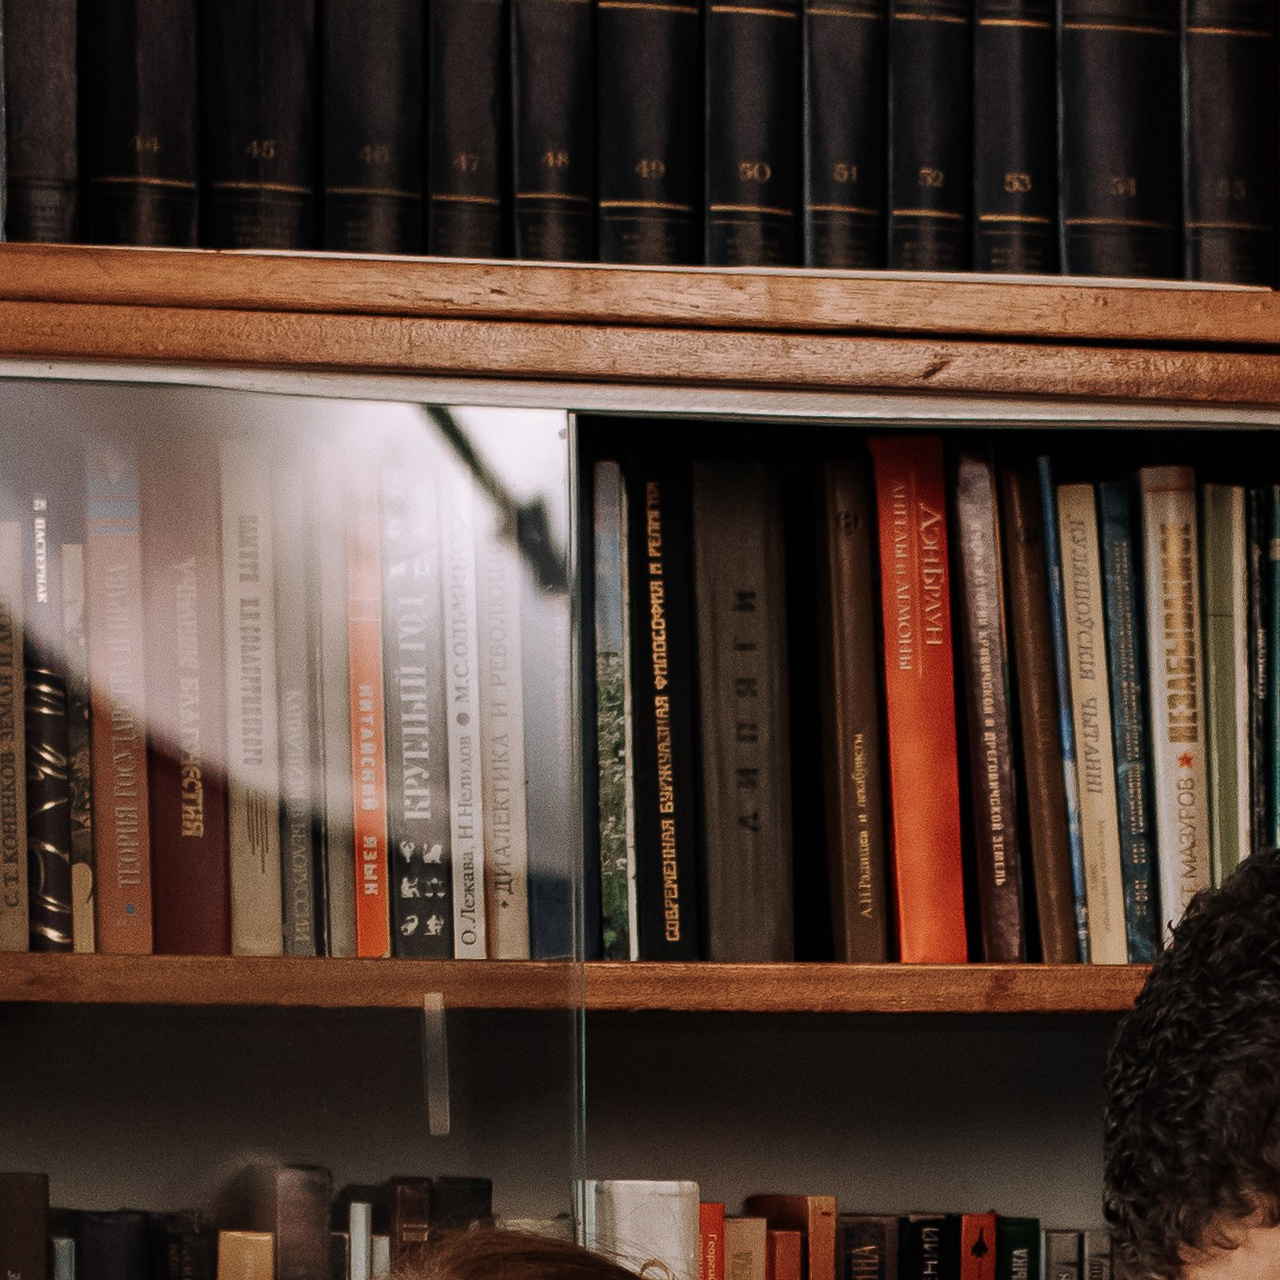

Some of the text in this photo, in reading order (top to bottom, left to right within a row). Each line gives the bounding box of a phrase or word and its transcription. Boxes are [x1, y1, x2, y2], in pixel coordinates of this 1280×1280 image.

[246, 139, 275, 159] 45
[452, 153, 480, 172] 47
[545, 151, 570, 169] 48
[634, 160, 667, 179] 49
[738, 161, 772, 184] 50
[833, 164, 858, 183] 51
[918, 168, 946, 188] 52
[1003, 173, 1033, 193] 53
[34, 517, 48, 604] ПАСТЕРНАК
[649, 562, 663, 576] И
[1066, 515, 1096, 680] КУЛЯШОЎСКІЯ
[396, 593, 430, 652] ГОД
[648, 580, 669, 691] ФИЛОСОФИЯ
[0, 674, 16, 742] ЗЕМЛЯ
[979, 630, 996, 716] КРИВИЧСКОЙ
[179, 677, 205, 838] БЛАГОЧЕСТИЯ
[359, 683, 378, 811] КИТАЙСКИЙ
[395, 664, 433, 821] КРУГЛЫЙ
[453, 734, 474, 817] Нелидов
[653, 695, 677, 814] БУРЖУАЗНАЯ
[850, 733, 867, 808] декабристы
[984, 730, 1004, 831] ДРЕГОВИЧСКОЙ
[1079, 697, 1104, 795] ЧЫТАННІ
[490, 700, 518, 893] ДИАЛЕКТИКА И
[1177, 777, 1198, 879] МАЗУРОВ
[114, 805, 142, 889] ТЕОРИЯ
[290, 822, 312, 941] БЕЛОРУССИИ
[659, 818, 681, 942] СОВРЕМЕННАЯ
[991, 835, 1007, 887] ЗЕМЕЛЬ
